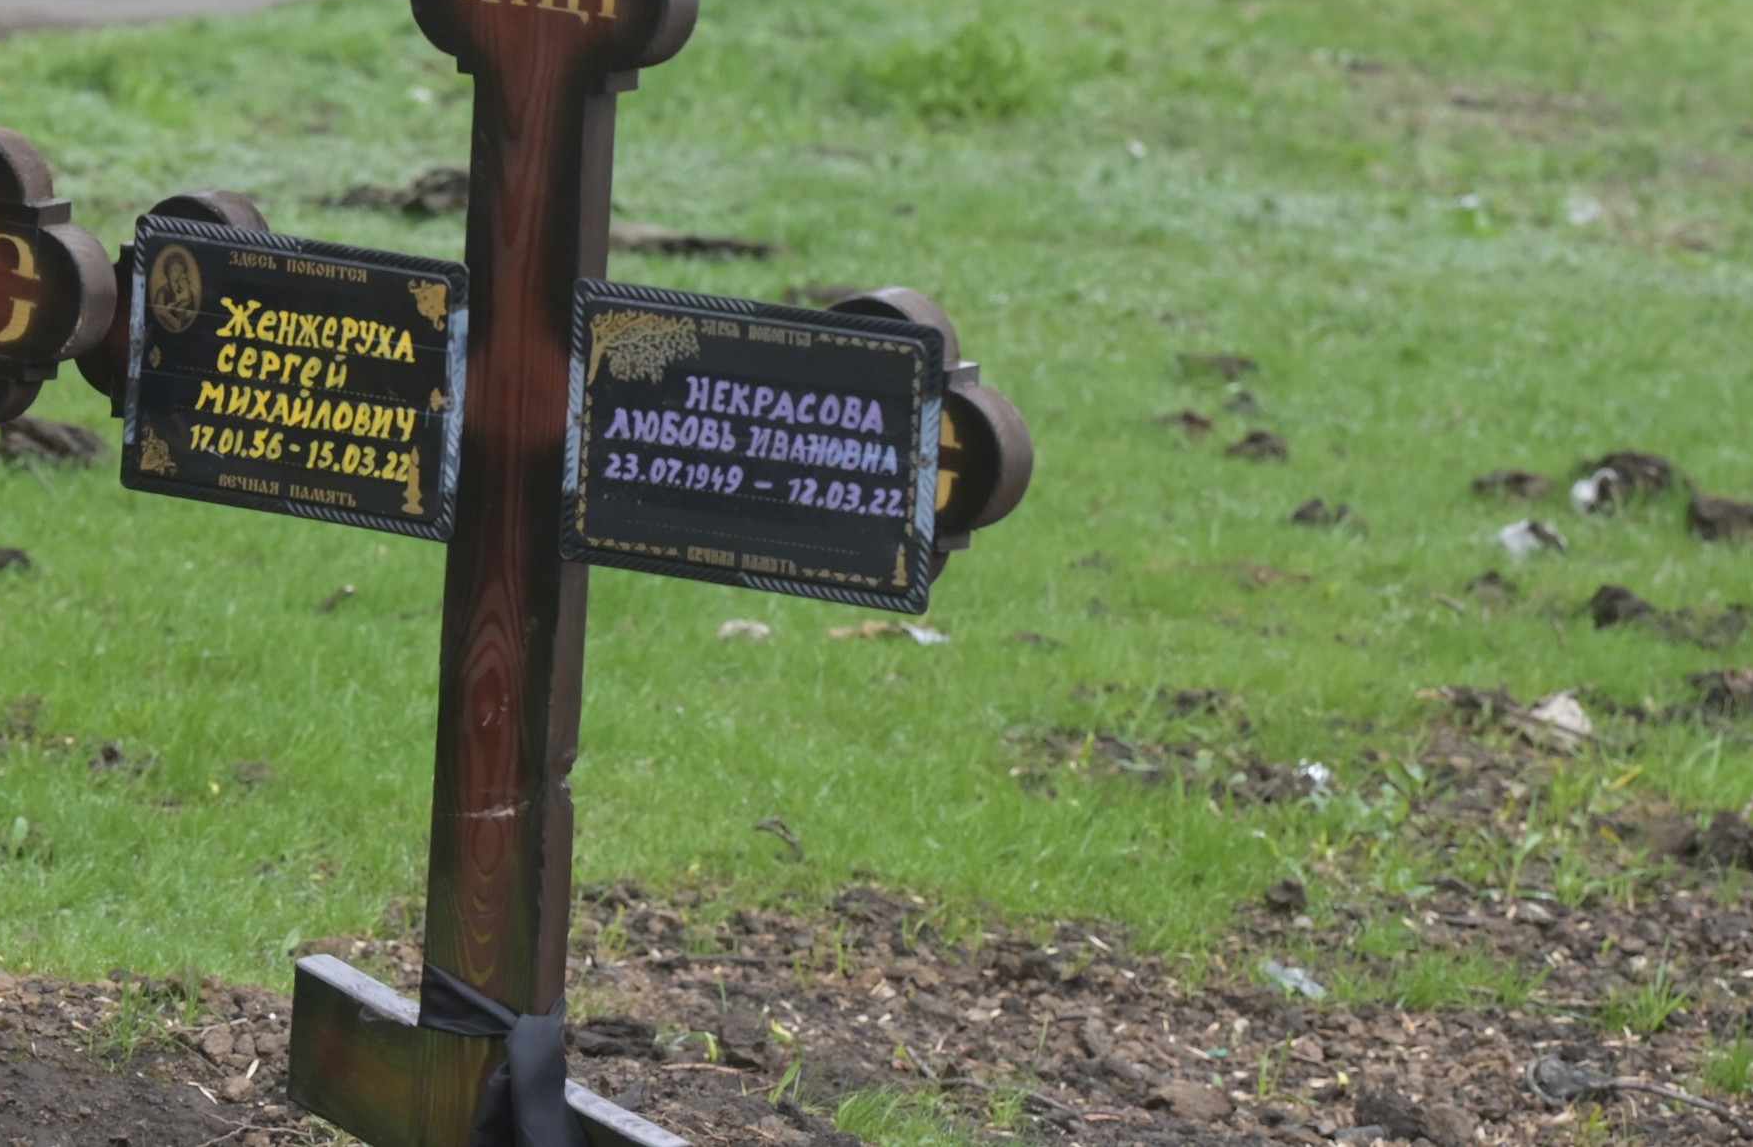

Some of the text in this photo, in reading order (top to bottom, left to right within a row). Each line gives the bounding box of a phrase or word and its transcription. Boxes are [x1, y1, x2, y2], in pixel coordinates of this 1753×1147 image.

[229, 250, 369, 284] ЗДЕСЬ ПОКОИТСЯ
[194, 380, 417, 443] МИХАЙЛОВИЧ
[684, 375, 885, 435] НЕКРАСОВА
[189, 423, 284, 460] 17.01.56
[305, 439, 411, 483] 15.03.22
[603, 407, 737, 453] ЛЮБОВЬ
[745, 425, 899, 476] ИВАНОВНА
[218, 473, 357, 508] ВЕЧНАЯ ПАМЯТЬ
[603, 452, 745, 495] 23.07.1949
